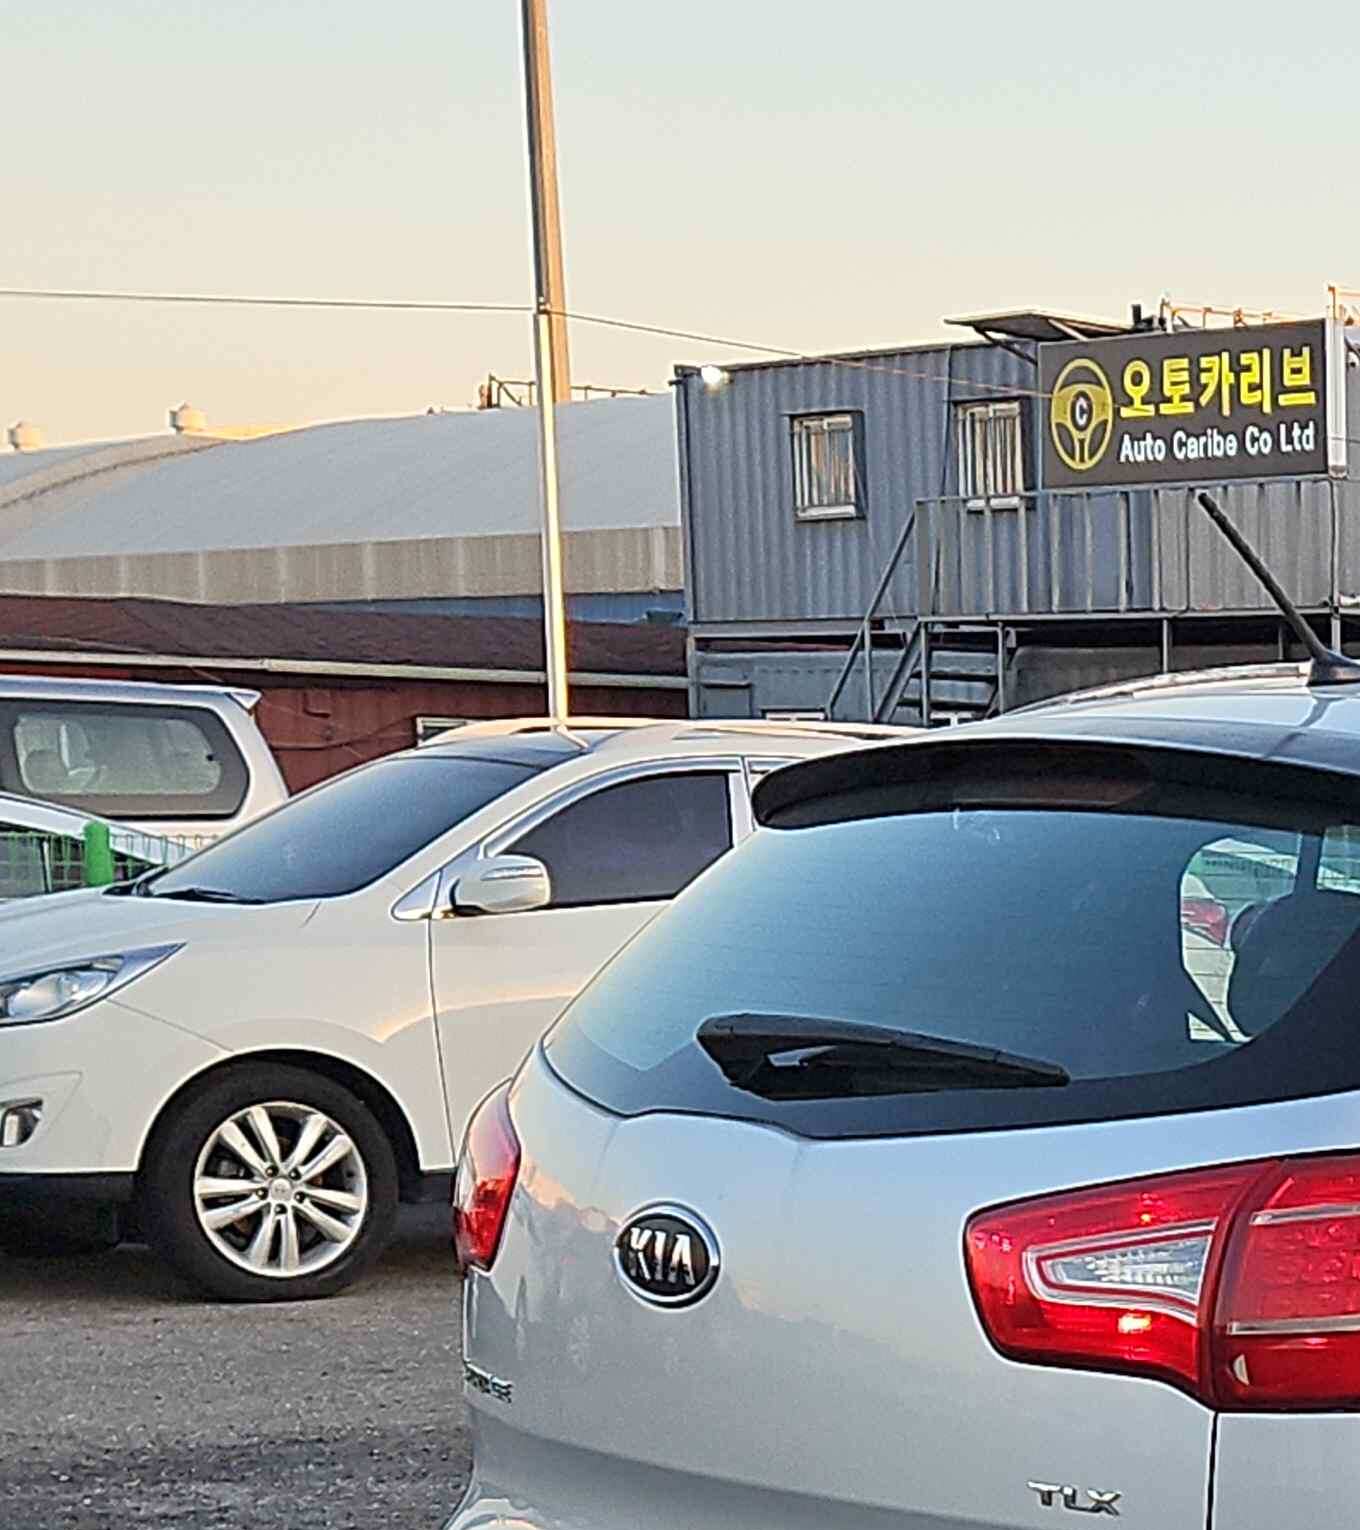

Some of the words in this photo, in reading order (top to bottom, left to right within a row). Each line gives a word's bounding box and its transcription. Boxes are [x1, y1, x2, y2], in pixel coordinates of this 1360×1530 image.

[1120, 346, 1316, 418] 오토카리브
[1120, 433, 1166, 463] Auto
[1173, 428, 1237, 460] Caribe
[1245, 425, 1273, 455] Co
[1279, 421, 1316, 452] Ltd
[629, 1226, 696, 1286] KIA
[1026, 1480, 1122, 1517] TLX
